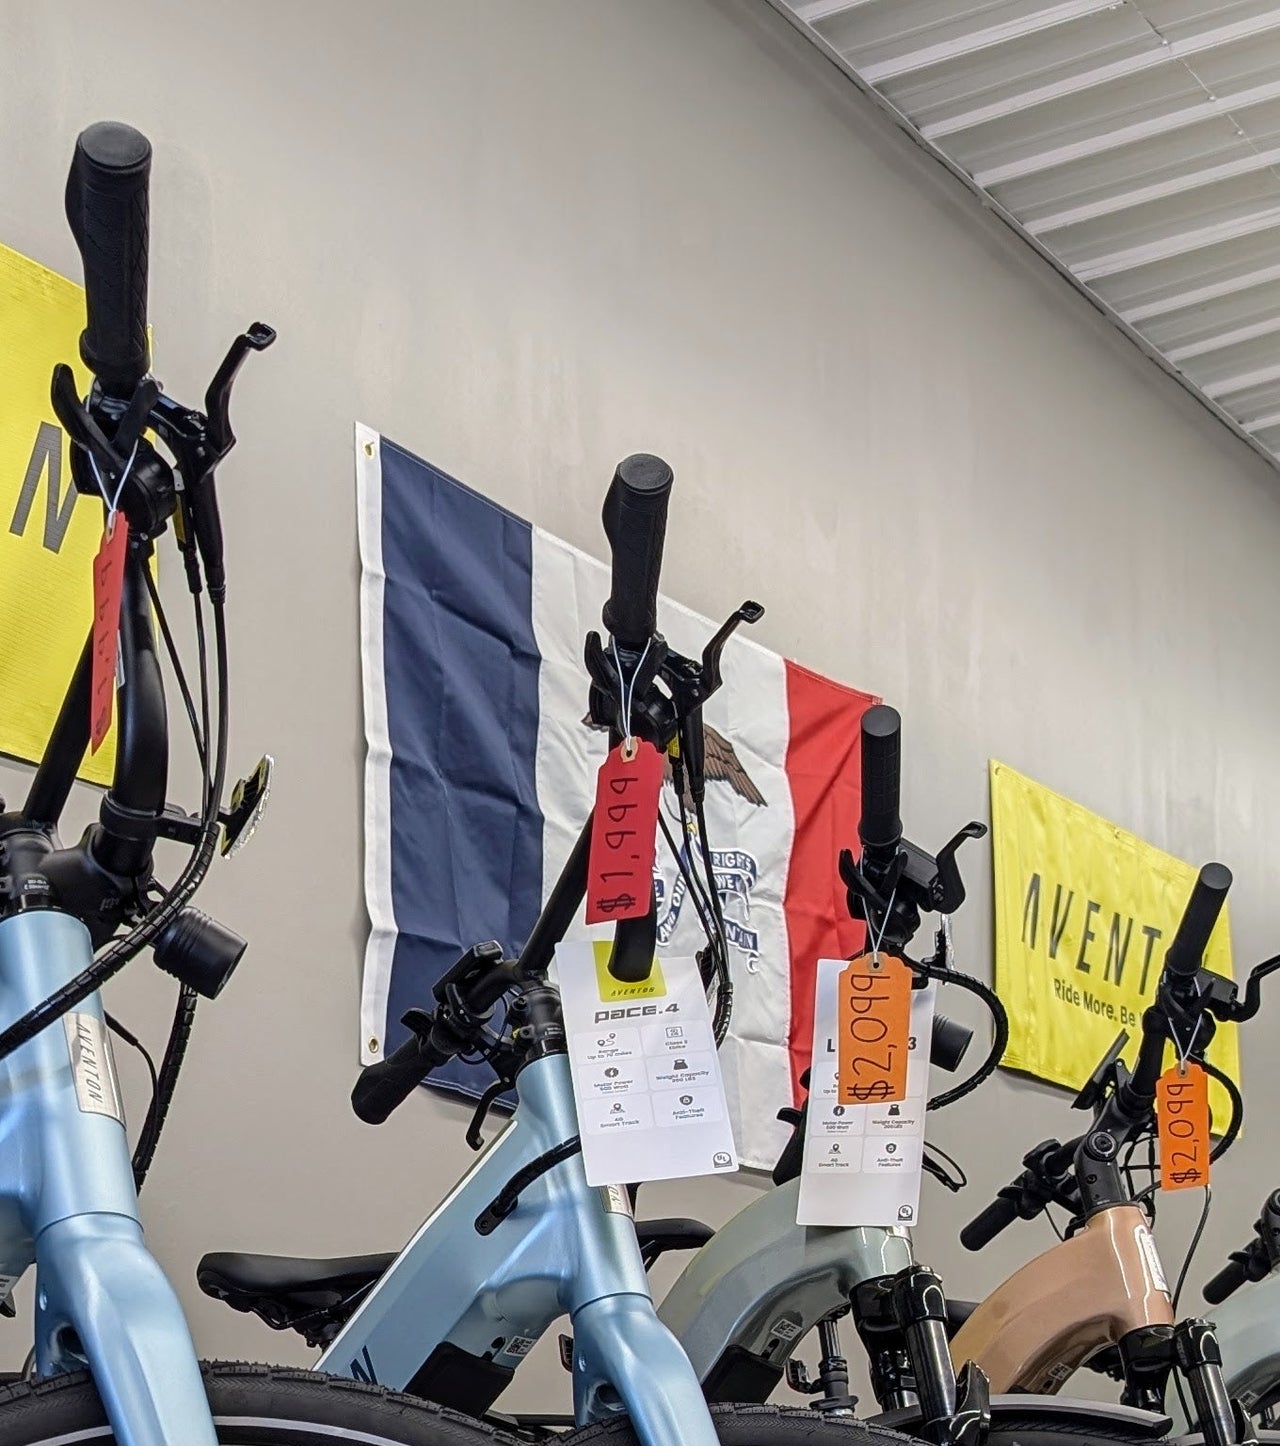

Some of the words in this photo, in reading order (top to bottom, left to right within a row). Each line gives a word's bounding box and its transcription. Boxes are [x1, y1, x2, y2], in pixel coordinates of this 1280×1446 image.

[596, 778, 640, 913] $1,999
[1021, 872, 1162, 996] AVENT
[847, 974, 897, 1101] $2,099
[1053, 978, 1080, 1006] Ride
[1083, 990, 1118, 1022] More.
[1120, 1005, 1136, 1027] Be
[76, 1021, 104, 1104] AVENTON
[1166, 1084, 1202, 1183] $2,099
